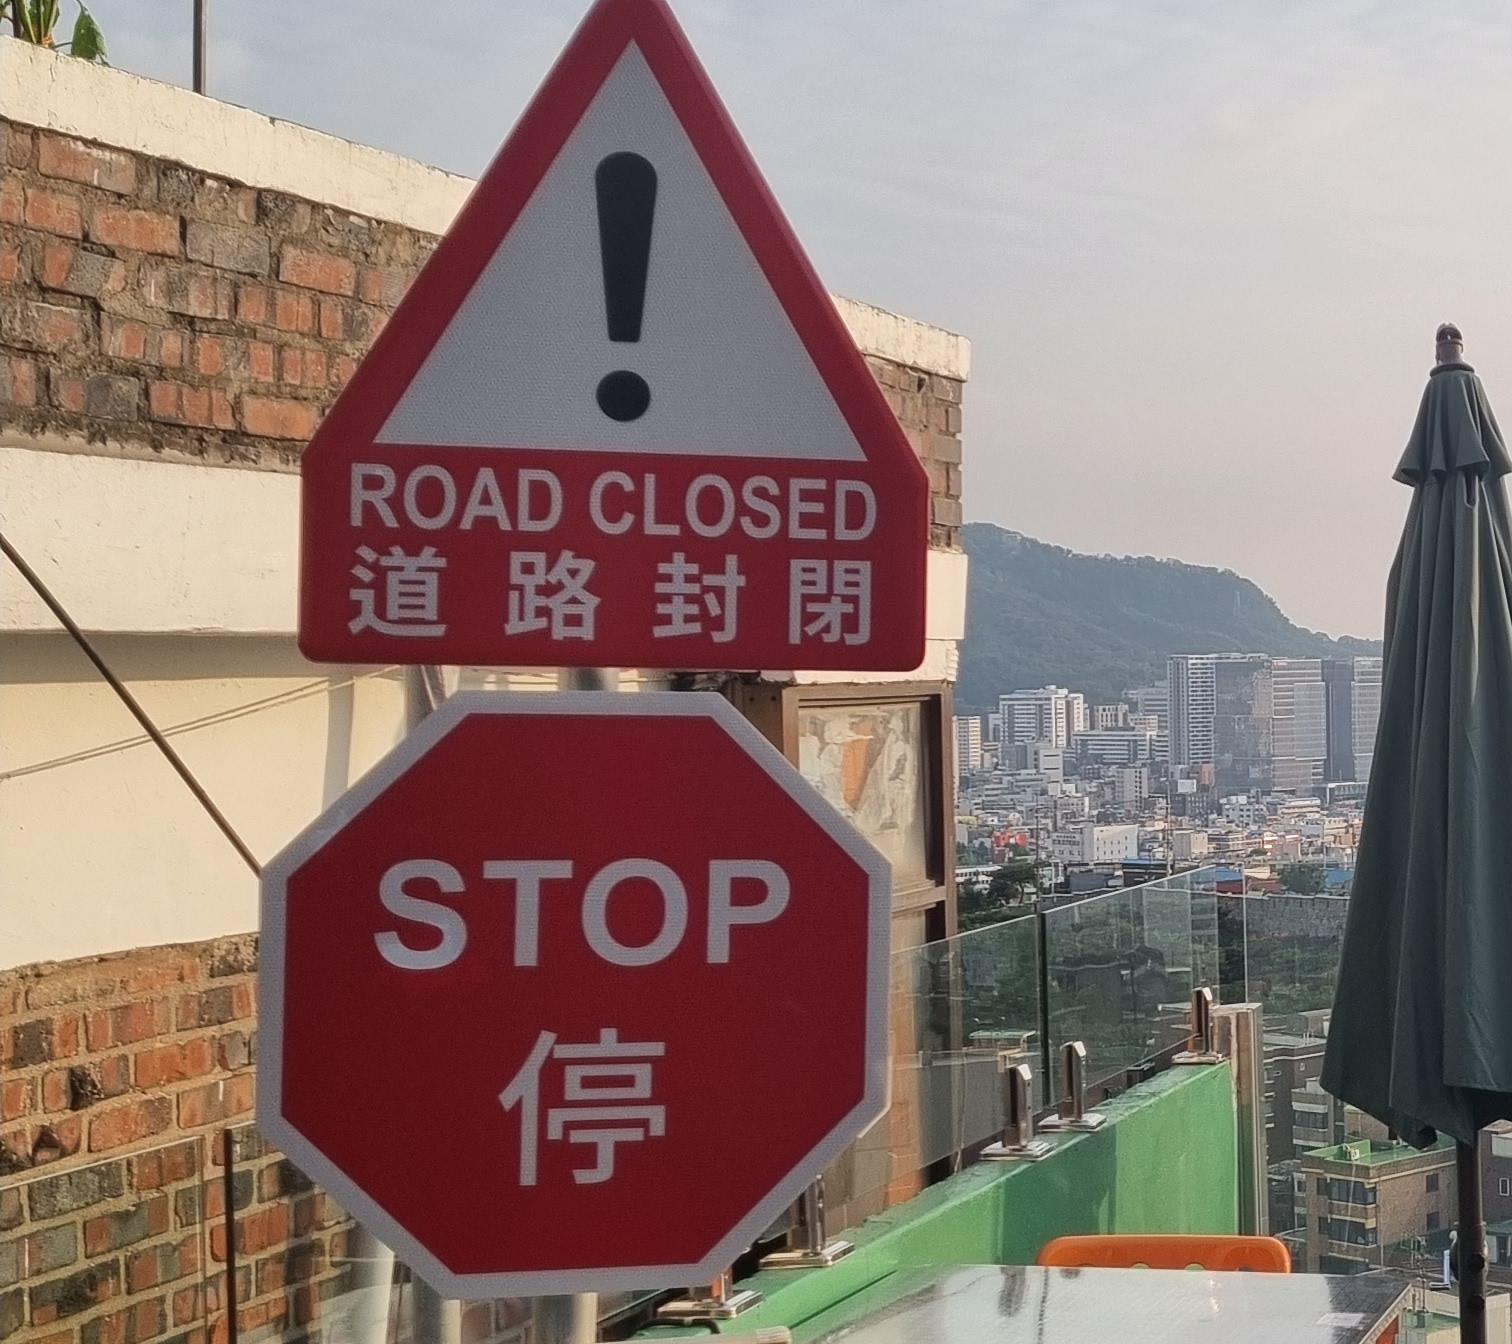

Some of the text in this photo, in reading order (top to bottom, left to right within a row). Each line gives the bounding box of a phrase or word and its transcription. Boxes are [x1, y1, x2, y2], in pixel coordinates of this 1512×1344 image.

[348, 462, 878, 542] ROAD CLOSED
[347, 545, 873, 647] 道路封閉
[373, 857, 791, 970] STOP
[498, 1027, 666, 1187] 停
